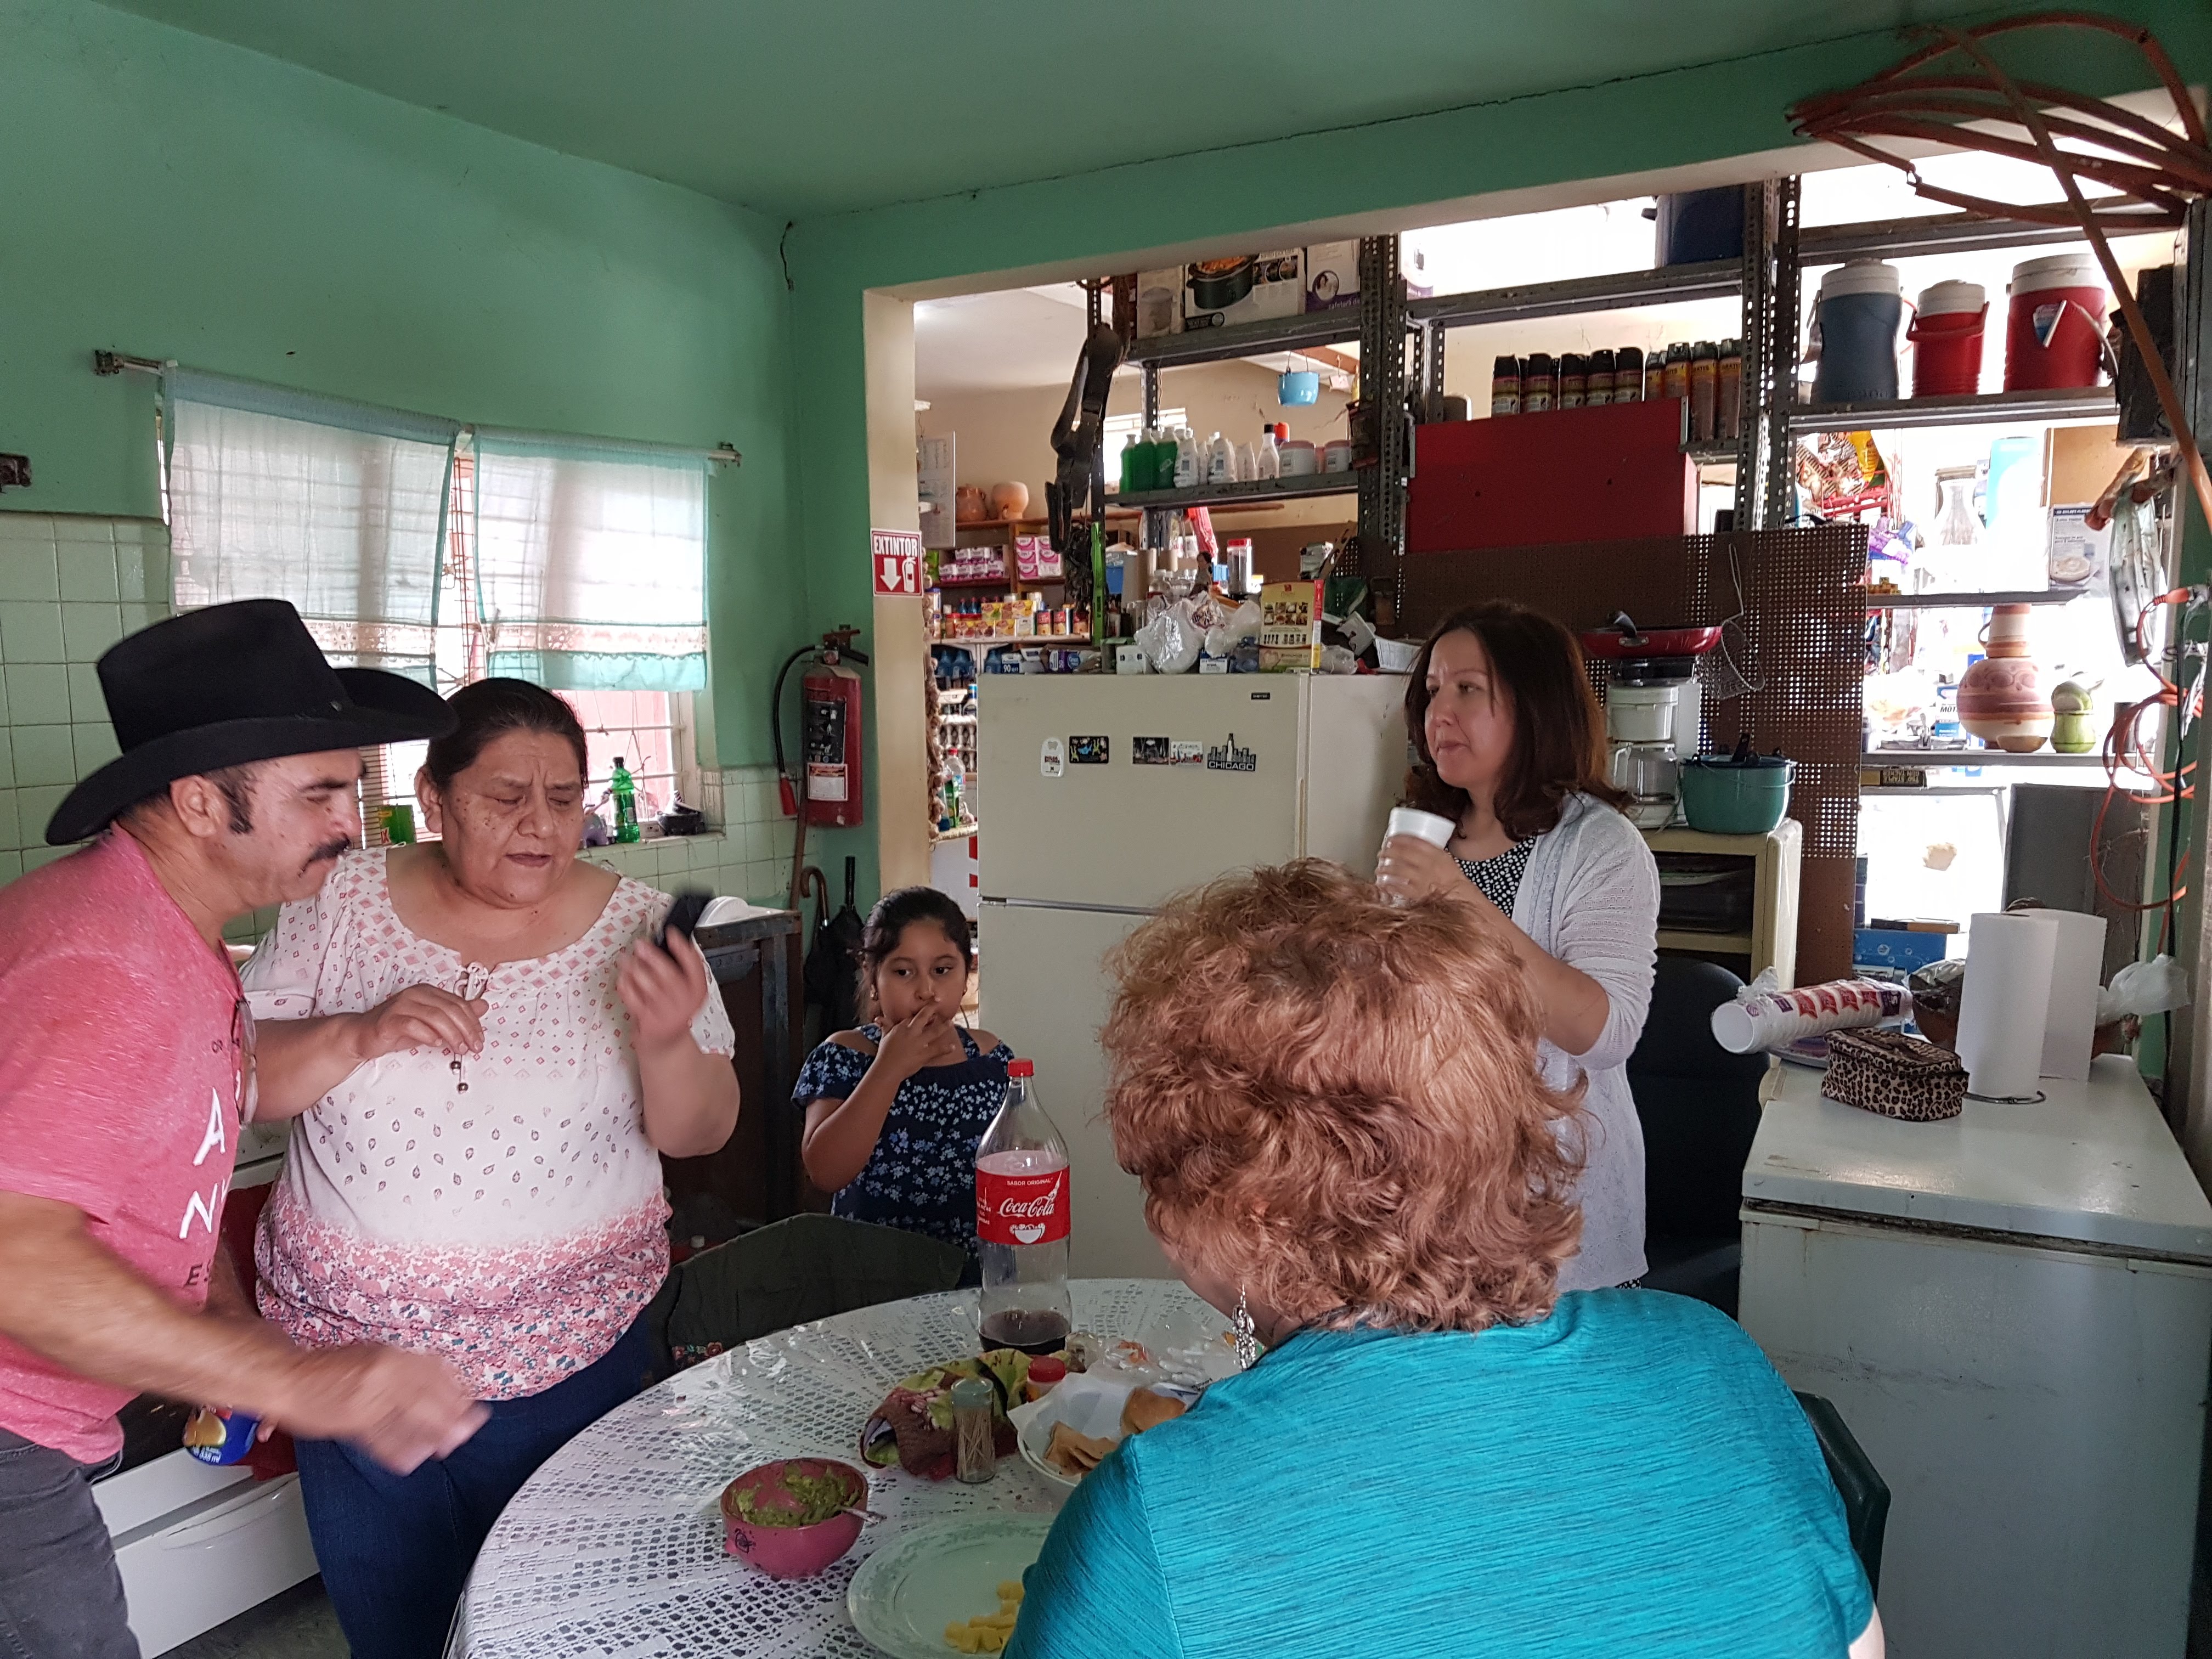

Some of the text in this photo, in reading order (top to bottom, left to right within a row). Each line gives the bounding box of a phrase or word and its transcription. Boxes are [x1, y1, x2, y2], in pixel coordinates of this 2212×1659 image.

[873, 535, 918, 558] EXTINTOR
[1003, 664, 1011, 673] 90
[1209, 761, 1254, 771] CHICAGO
[997, 1195, 1054, 1218] Coca-Cola
